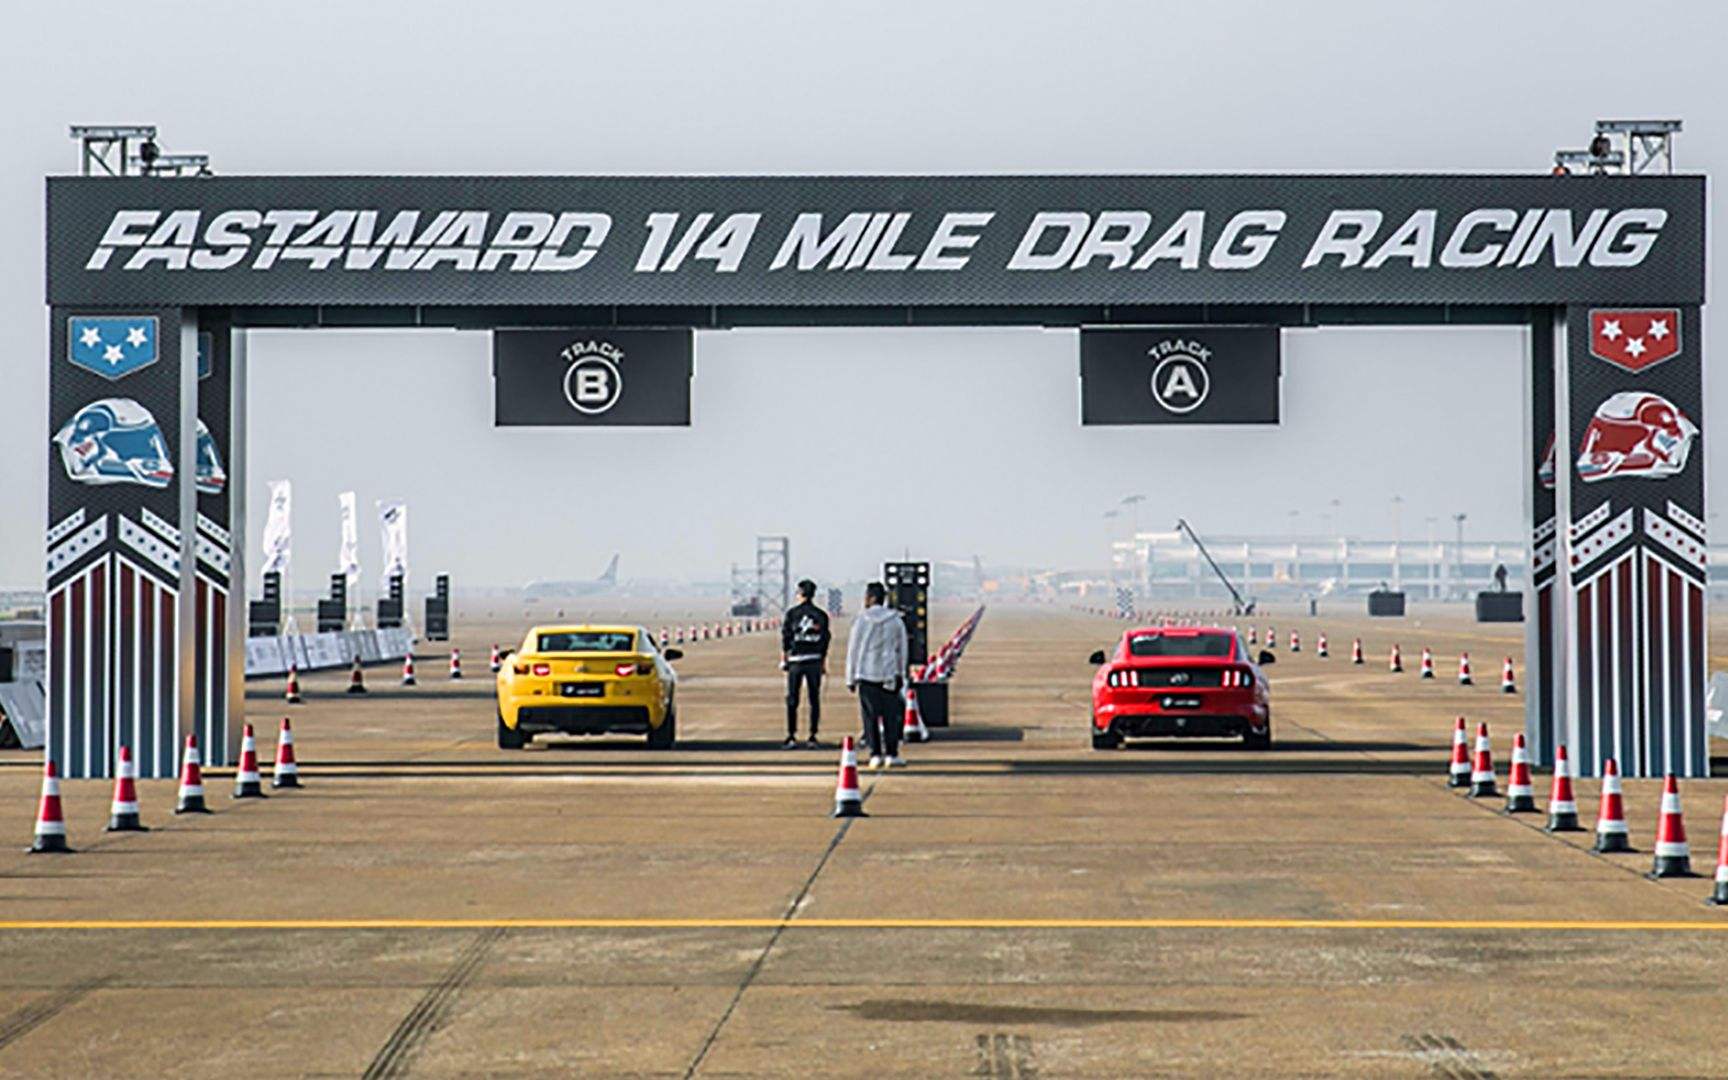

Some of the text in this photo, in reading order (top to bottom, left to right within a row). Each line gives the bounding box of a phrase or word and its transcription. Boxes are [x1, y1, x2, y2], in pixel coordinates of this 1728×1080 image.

[86, 208, 1667, 273] FAST4WARD 1/4 MILE DRAG RACING
[561, 340, 625, 364] TRACK
[1147, 339, 1212, 362] TRACK
[576, 368, 609, 402] B
[1162, 364, 1199, 399] A
